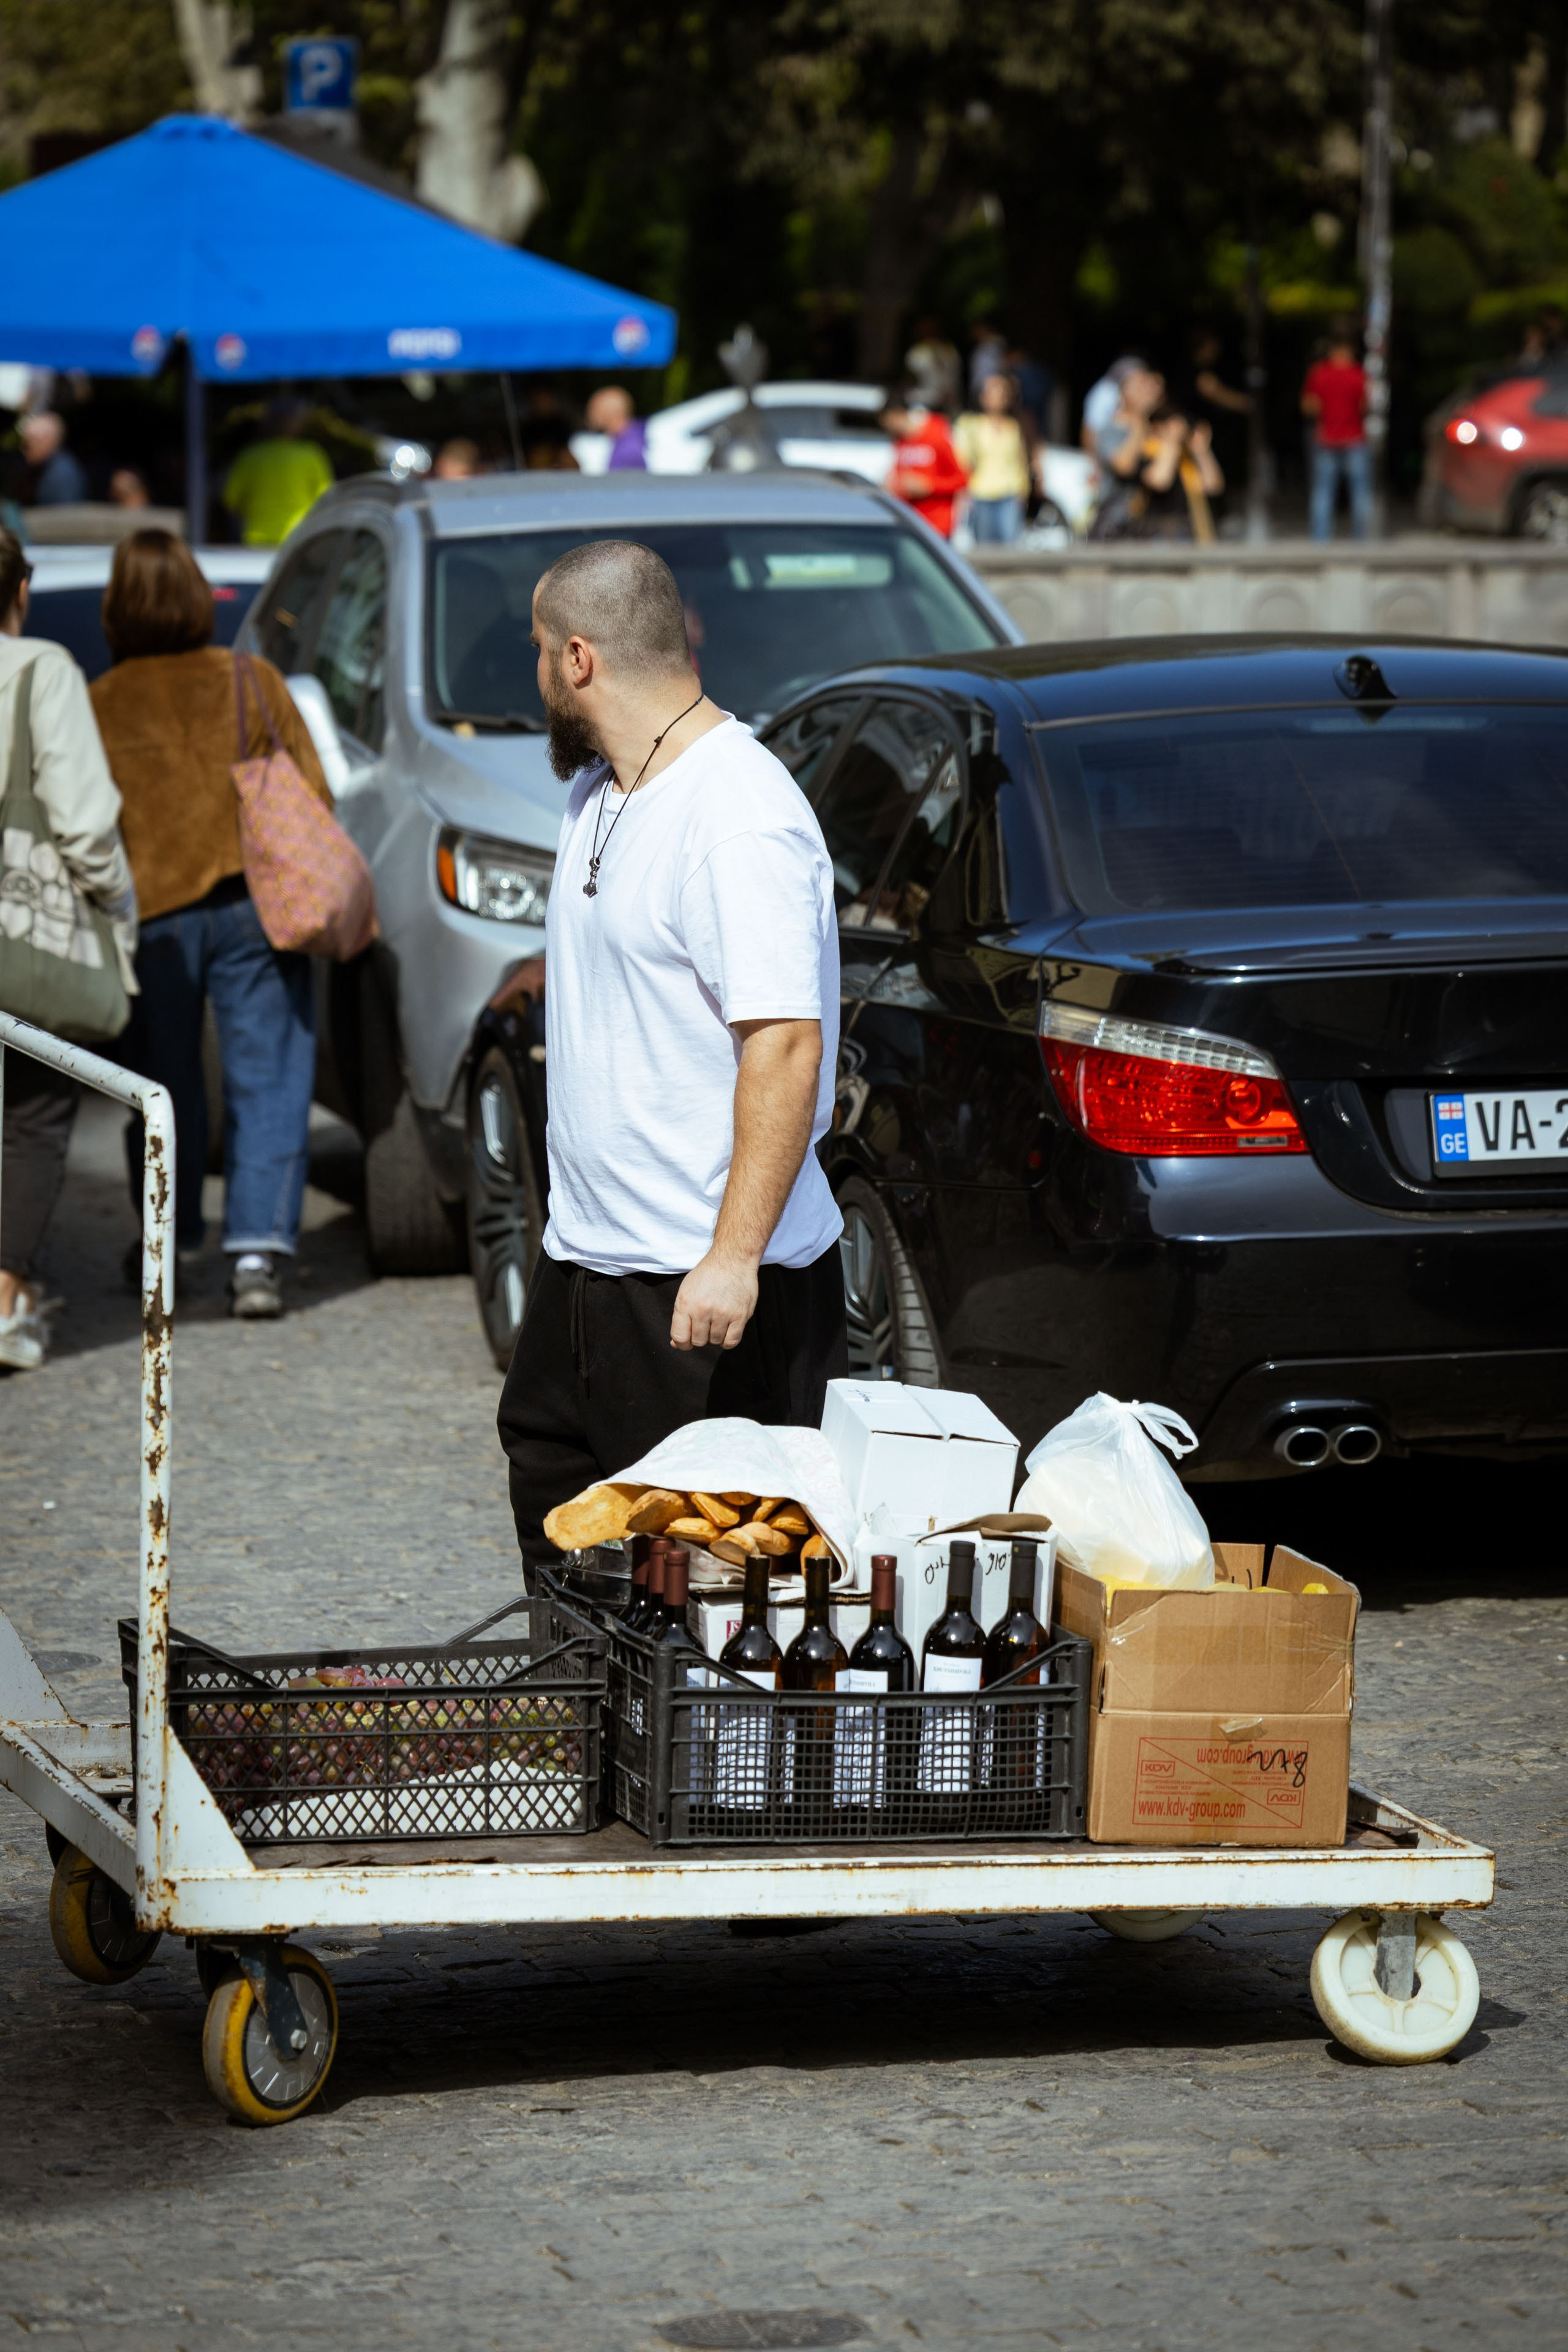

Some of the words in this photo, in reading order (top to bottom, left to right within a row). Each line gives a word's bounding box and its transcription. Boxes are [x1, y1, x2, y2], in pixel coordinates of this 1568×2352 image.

[299, 45, 343, 102] P
[1441, 1133, 1466, 1154] GE
[1145, 1763, 1173, 1772] KDV
[1270, 1793, 1297, 1802] KDV
[1139, 1796, 1246, 1822] www.kdv-group.com
